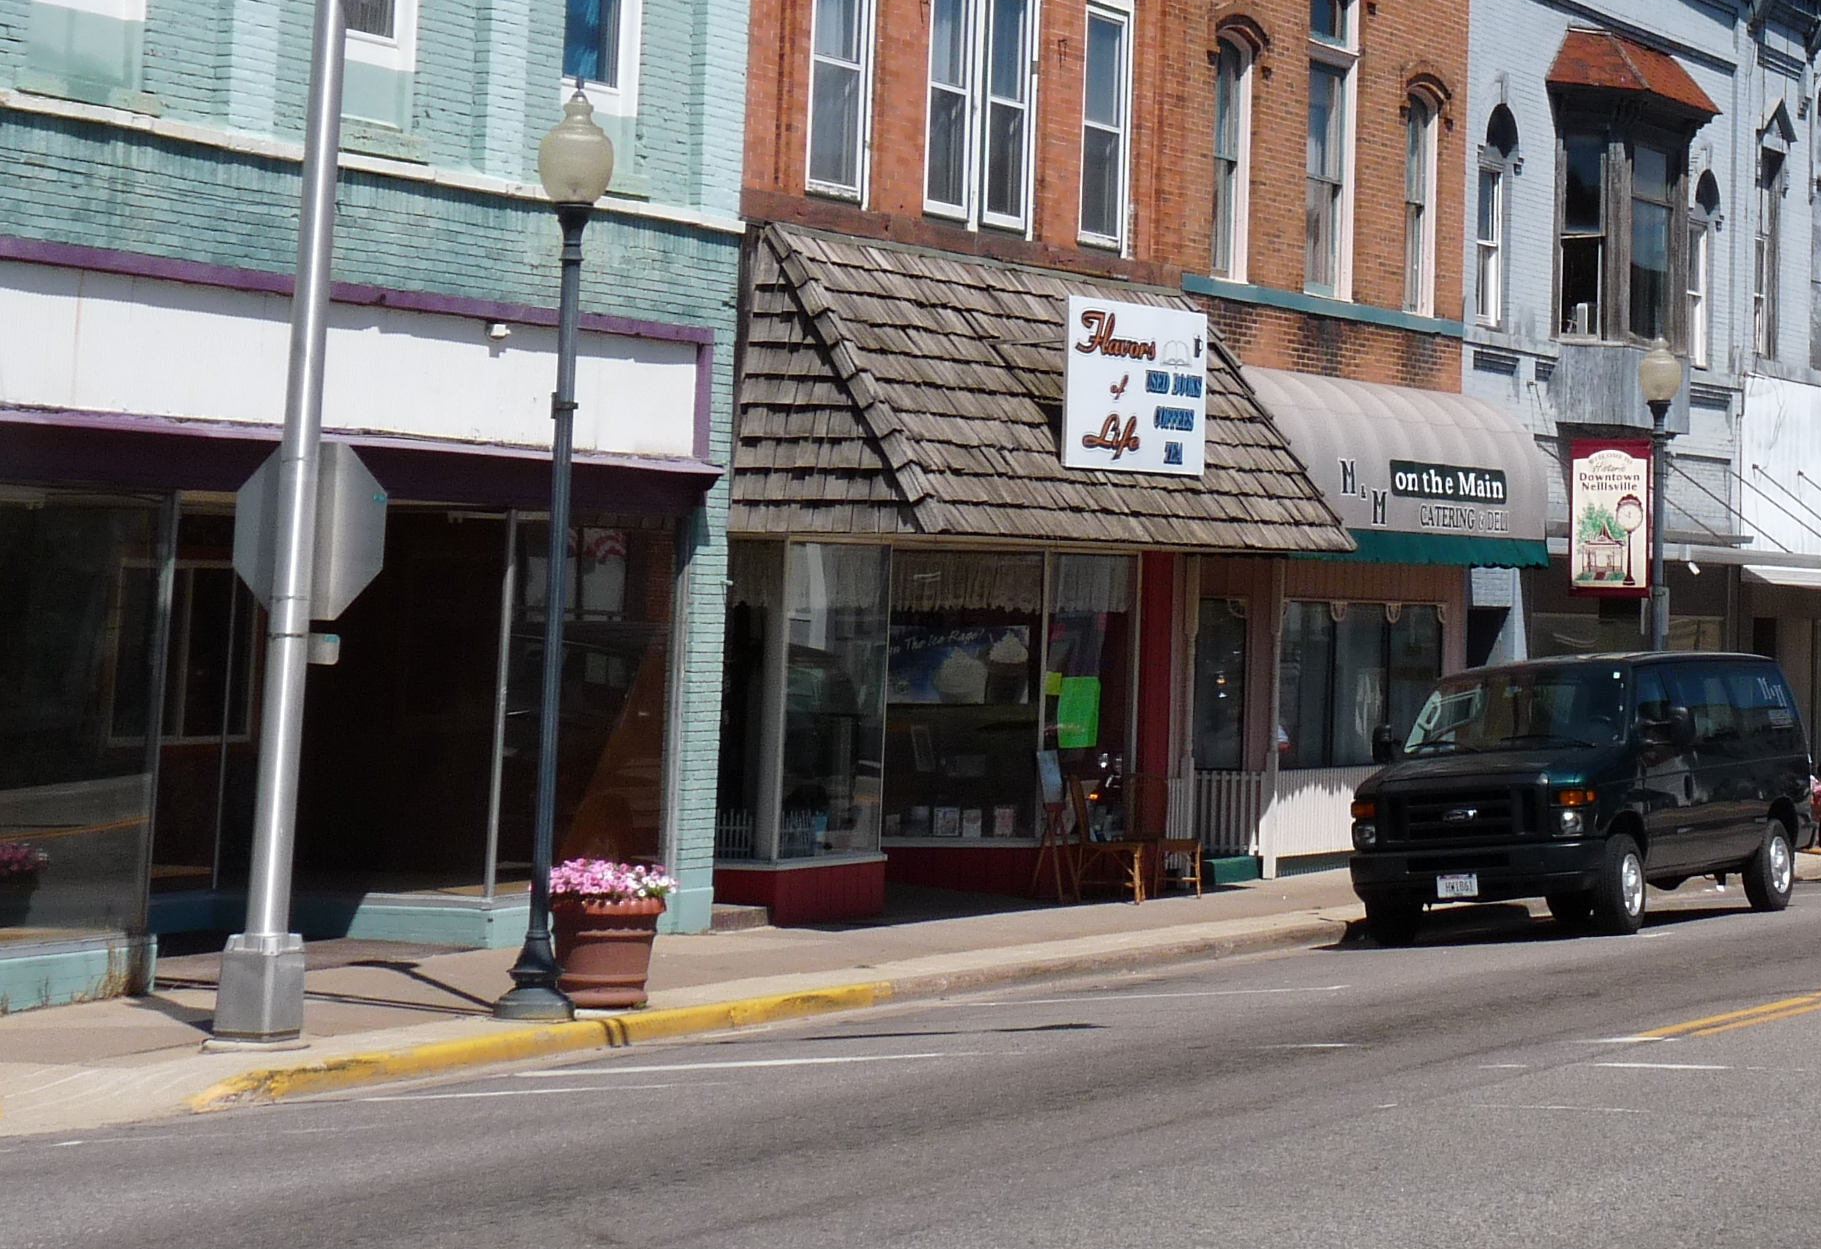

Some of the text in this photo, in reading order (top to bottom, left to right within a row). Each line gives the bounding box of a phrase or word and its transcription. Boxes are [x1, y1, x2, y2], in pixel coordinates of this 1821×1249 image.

[1075, 309, 1157, 362] Flavors
[1110, 374, 1129, 400] of
[1145, 369, 1203, 399] USED BOOKS
[1082, 413, 1141, 461] Life
[1395, 469, 1504, 499] on the Main
[1579, 472, 1640, 481] Downtown
[1581, 481, 1638, 491] Neillsville
[1339, 458, 1357, 495] M
[1371, 488, 1388, 526] M
[1420, 503, 1475, 531] CATERING
[1487, 510, 1509, 533] DELI
